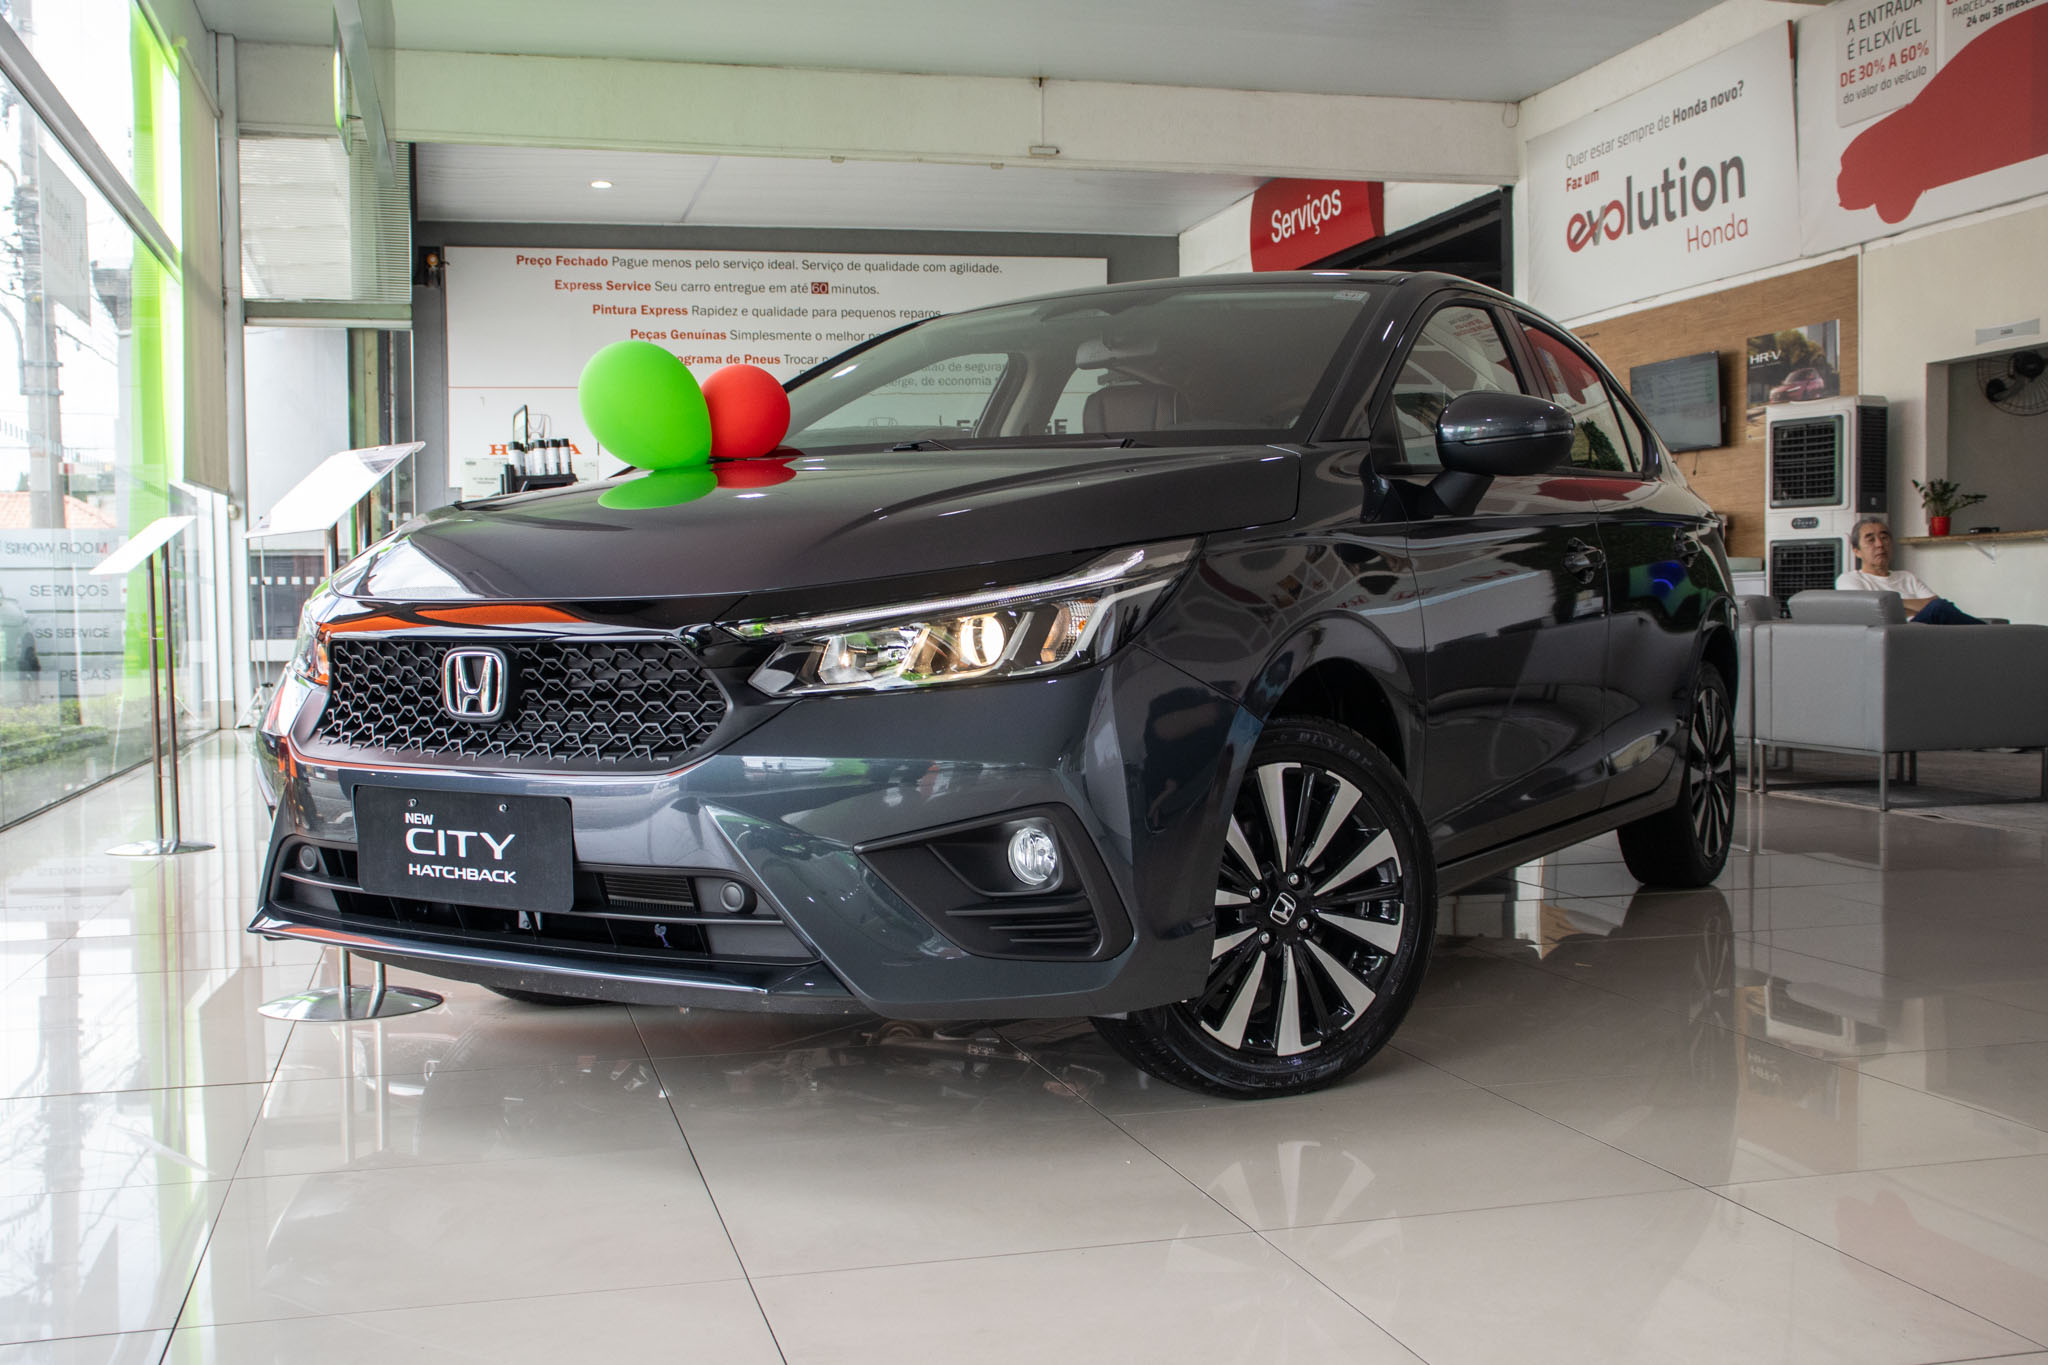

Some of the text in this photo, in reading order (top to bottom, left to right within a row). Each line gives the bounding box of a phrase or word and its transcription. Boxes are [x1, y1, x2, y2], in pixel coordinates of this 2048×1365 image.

[1966, 15, 1978, 28] 24
[1979, 11, 1991, 23] ou
[1992, 3, 2004, 17] 36
[1846, 18, 1856, 35] A
[1847, 17, 1922, 60] É FLEXÍVEL
[1840, 39, 1930, 87] DE 30% A 60%
[1842, 65, 1927, 104] do valor do veículo
[1566, 80, 1745, 170] Quer estar sempre de Honda novo?
[1566, 170, 1599, 192] Faz um
[1566, 156, 1746, 253] evolution
[1271, 188, 1342, 243] Serviços
[1686, 213, 1749, 253] Honda
[516, 255, 1003, 276] Preço Fechado Pague menos pelo serviço ideal. Serviço de qualidade com agilidade.
[554, 279, 880, 295] Express Service Seu carro entregue em até 60 minutos.
[592, 303, 637, 316] Pintura
[641, 304, 689, 318] Express
[691, 305, 738, 318] Rapidez
[741, 307, 749, 316] e
[751, 306, 808, 319] qualidade
[811, 308, 838, 319] para
[841, 309, 897, 319] pequenos
[630, 329, 667, 341] Peças
[670, 328, 727, 340] Genuínas
[729, 329, 812, 343] Simplesmente
[815, 332, 823, 341] o
[825, 330, 865, 341] melhor
[726, 354, 741, 364] de
[744, 354, 781, 365] Pneus
[784, 354, 818, 364] Trocar
[947, 362, 962, 372] de
[1750, 349, 1782, 365] HR-V
[921, 376, 935, 386] de
[938, 376, 992, 386] economia
[5, 542, 109, 554] SHOW ROOM
[30, 584, 110, 600] SERVIÇOS
[404, 812, 434, 825] NEW
[405, 827, 516, 860] CITY
[408, 863, 517, 884] HATCHBACK
